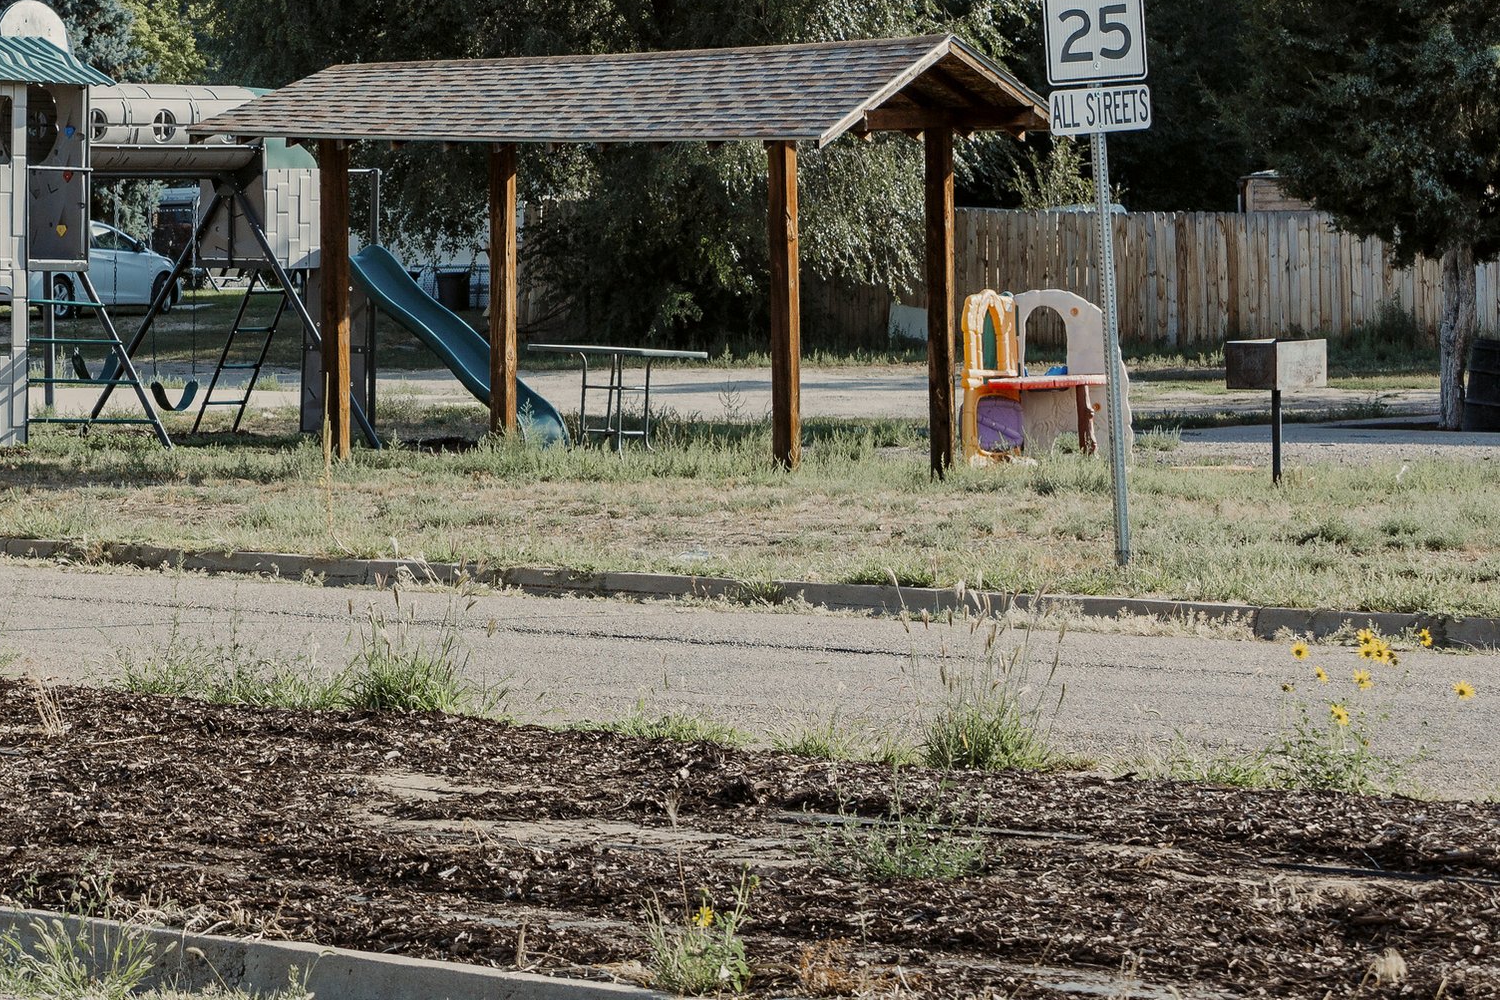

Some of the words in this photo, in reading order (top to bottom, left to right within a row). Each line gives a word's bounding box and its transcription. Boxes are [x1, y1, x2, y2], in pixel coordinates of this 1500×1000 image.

[1058, 3, 1132, 63] 25
[1053, 94, 1080, 129] ALL
[1086, 88, 1148, 125] STREETS
